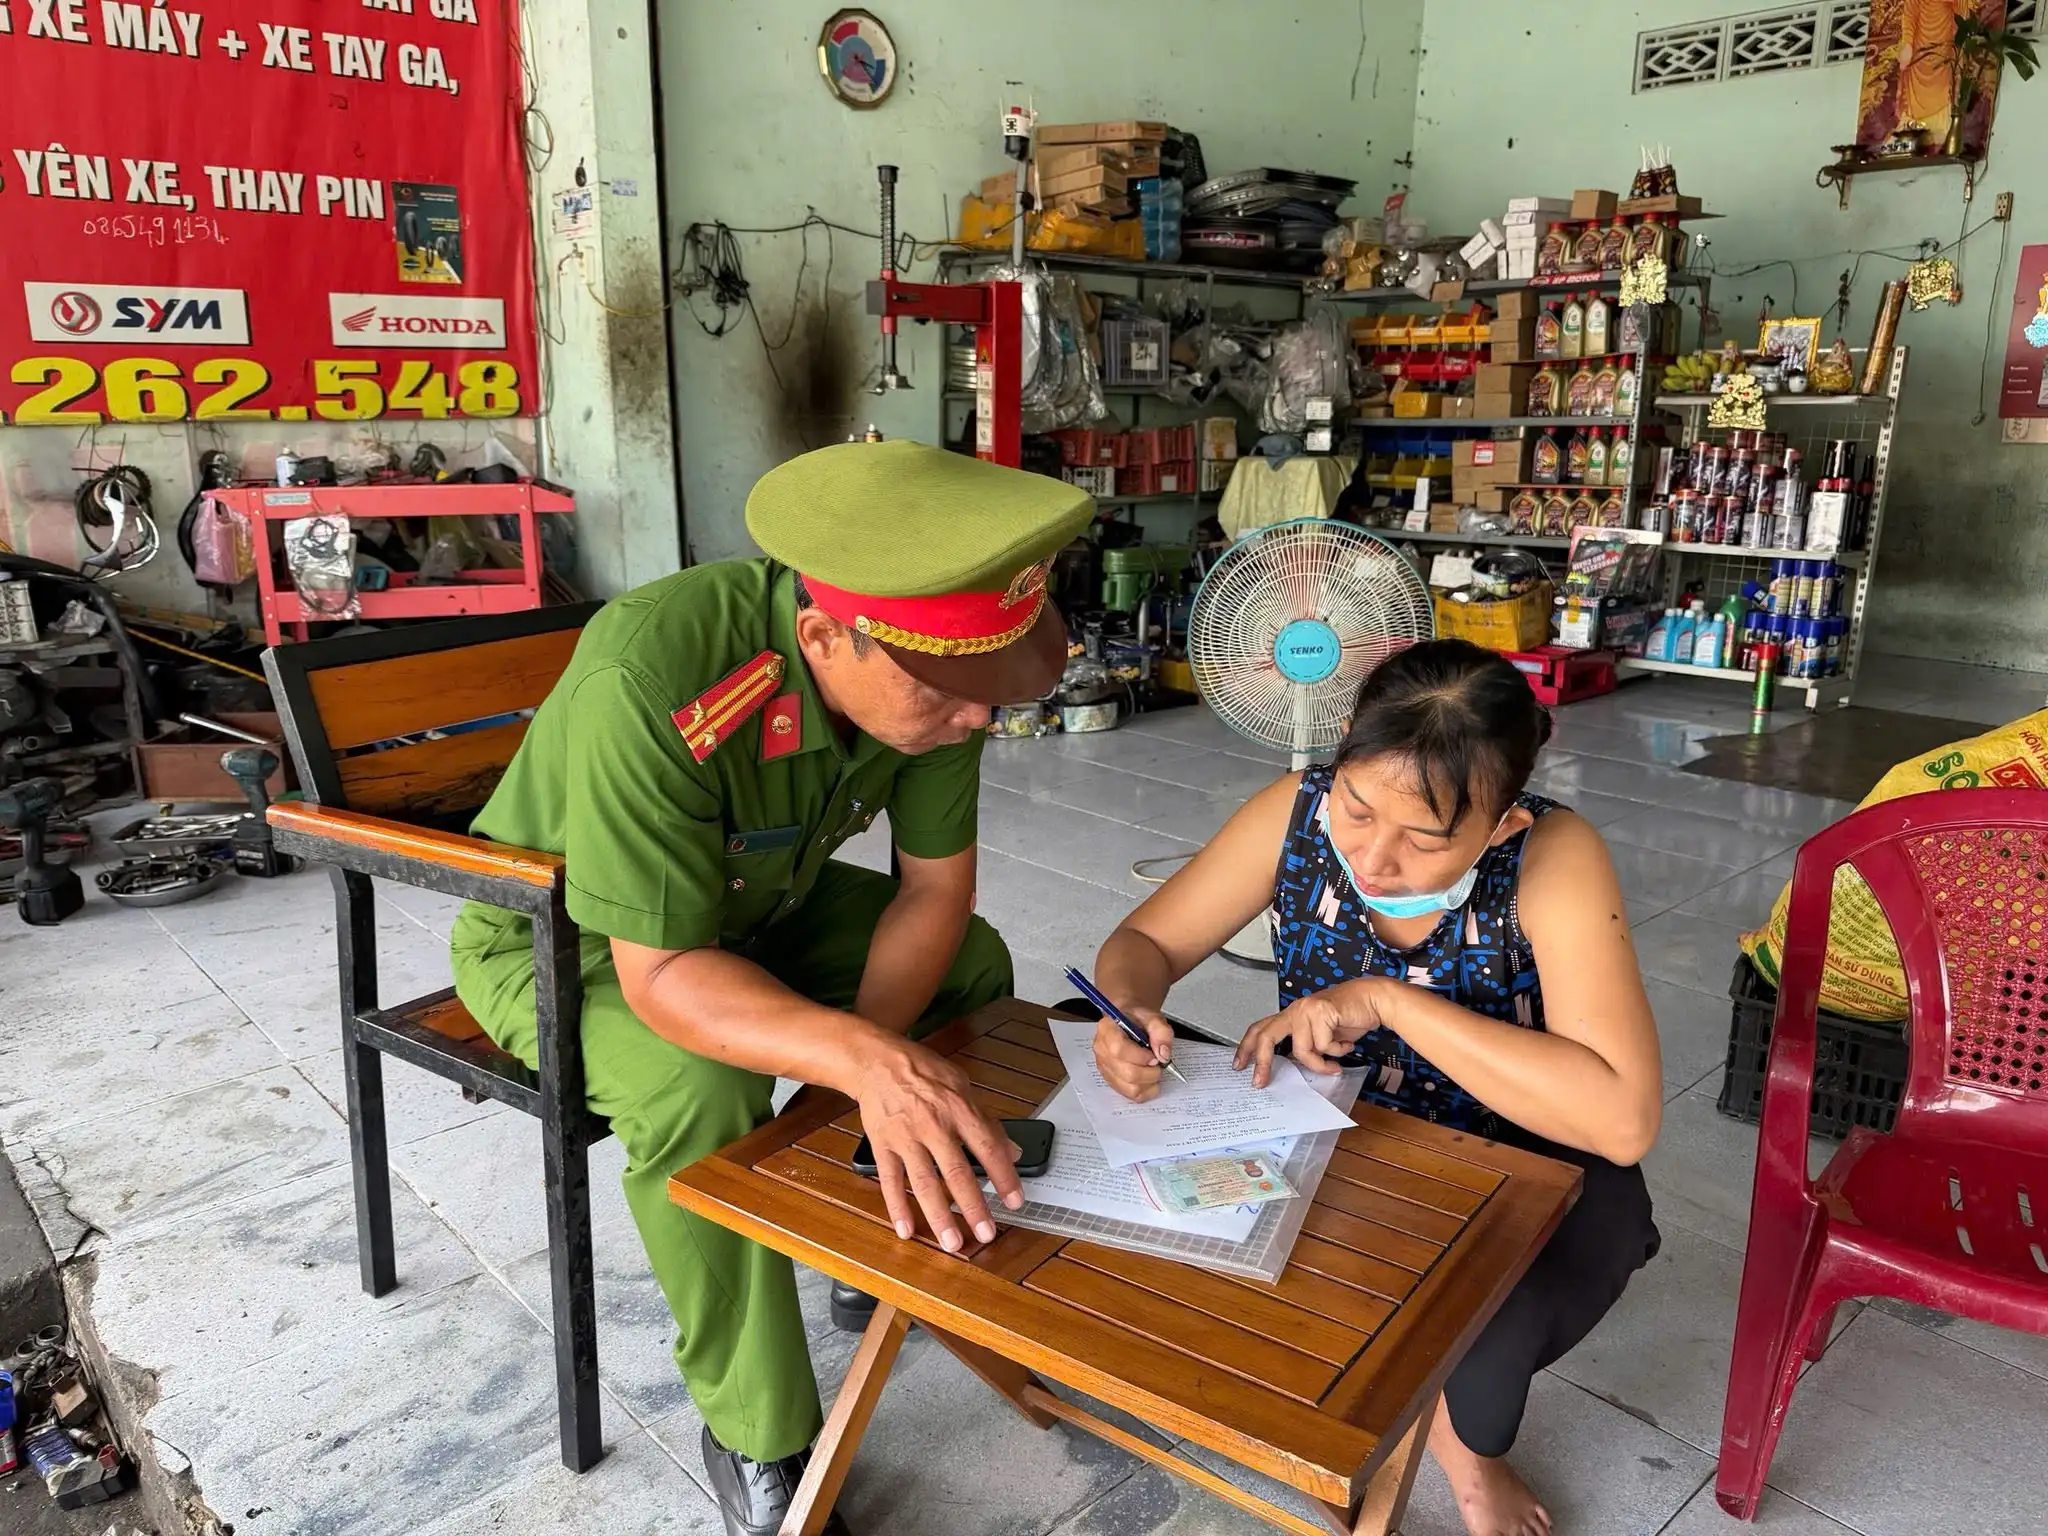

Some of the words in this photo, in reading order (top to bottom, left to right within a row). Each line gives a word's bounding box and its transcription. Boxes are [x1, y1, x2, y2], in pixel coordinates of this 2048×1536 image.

[28, 0, 89, 42] XE
[101, 0, 201, 57] MÁY
[258, 22, 314, 71] XE
[322, 31, 386, 81] TAY
[398, 43, 459, 95] GA,
[12, 142, 111, 200] YÊN
[121, 157, 195, 210] XE,
[203, 165, 303, 213] THAY
[316, 174, 385, 219] PIN
[112, 297, 222, 333] SYM
[379, 316, 496, 335] HONDA
[0, 356, 520, 426] 262.548
[1289, 645, 1324, 655] SENKO
